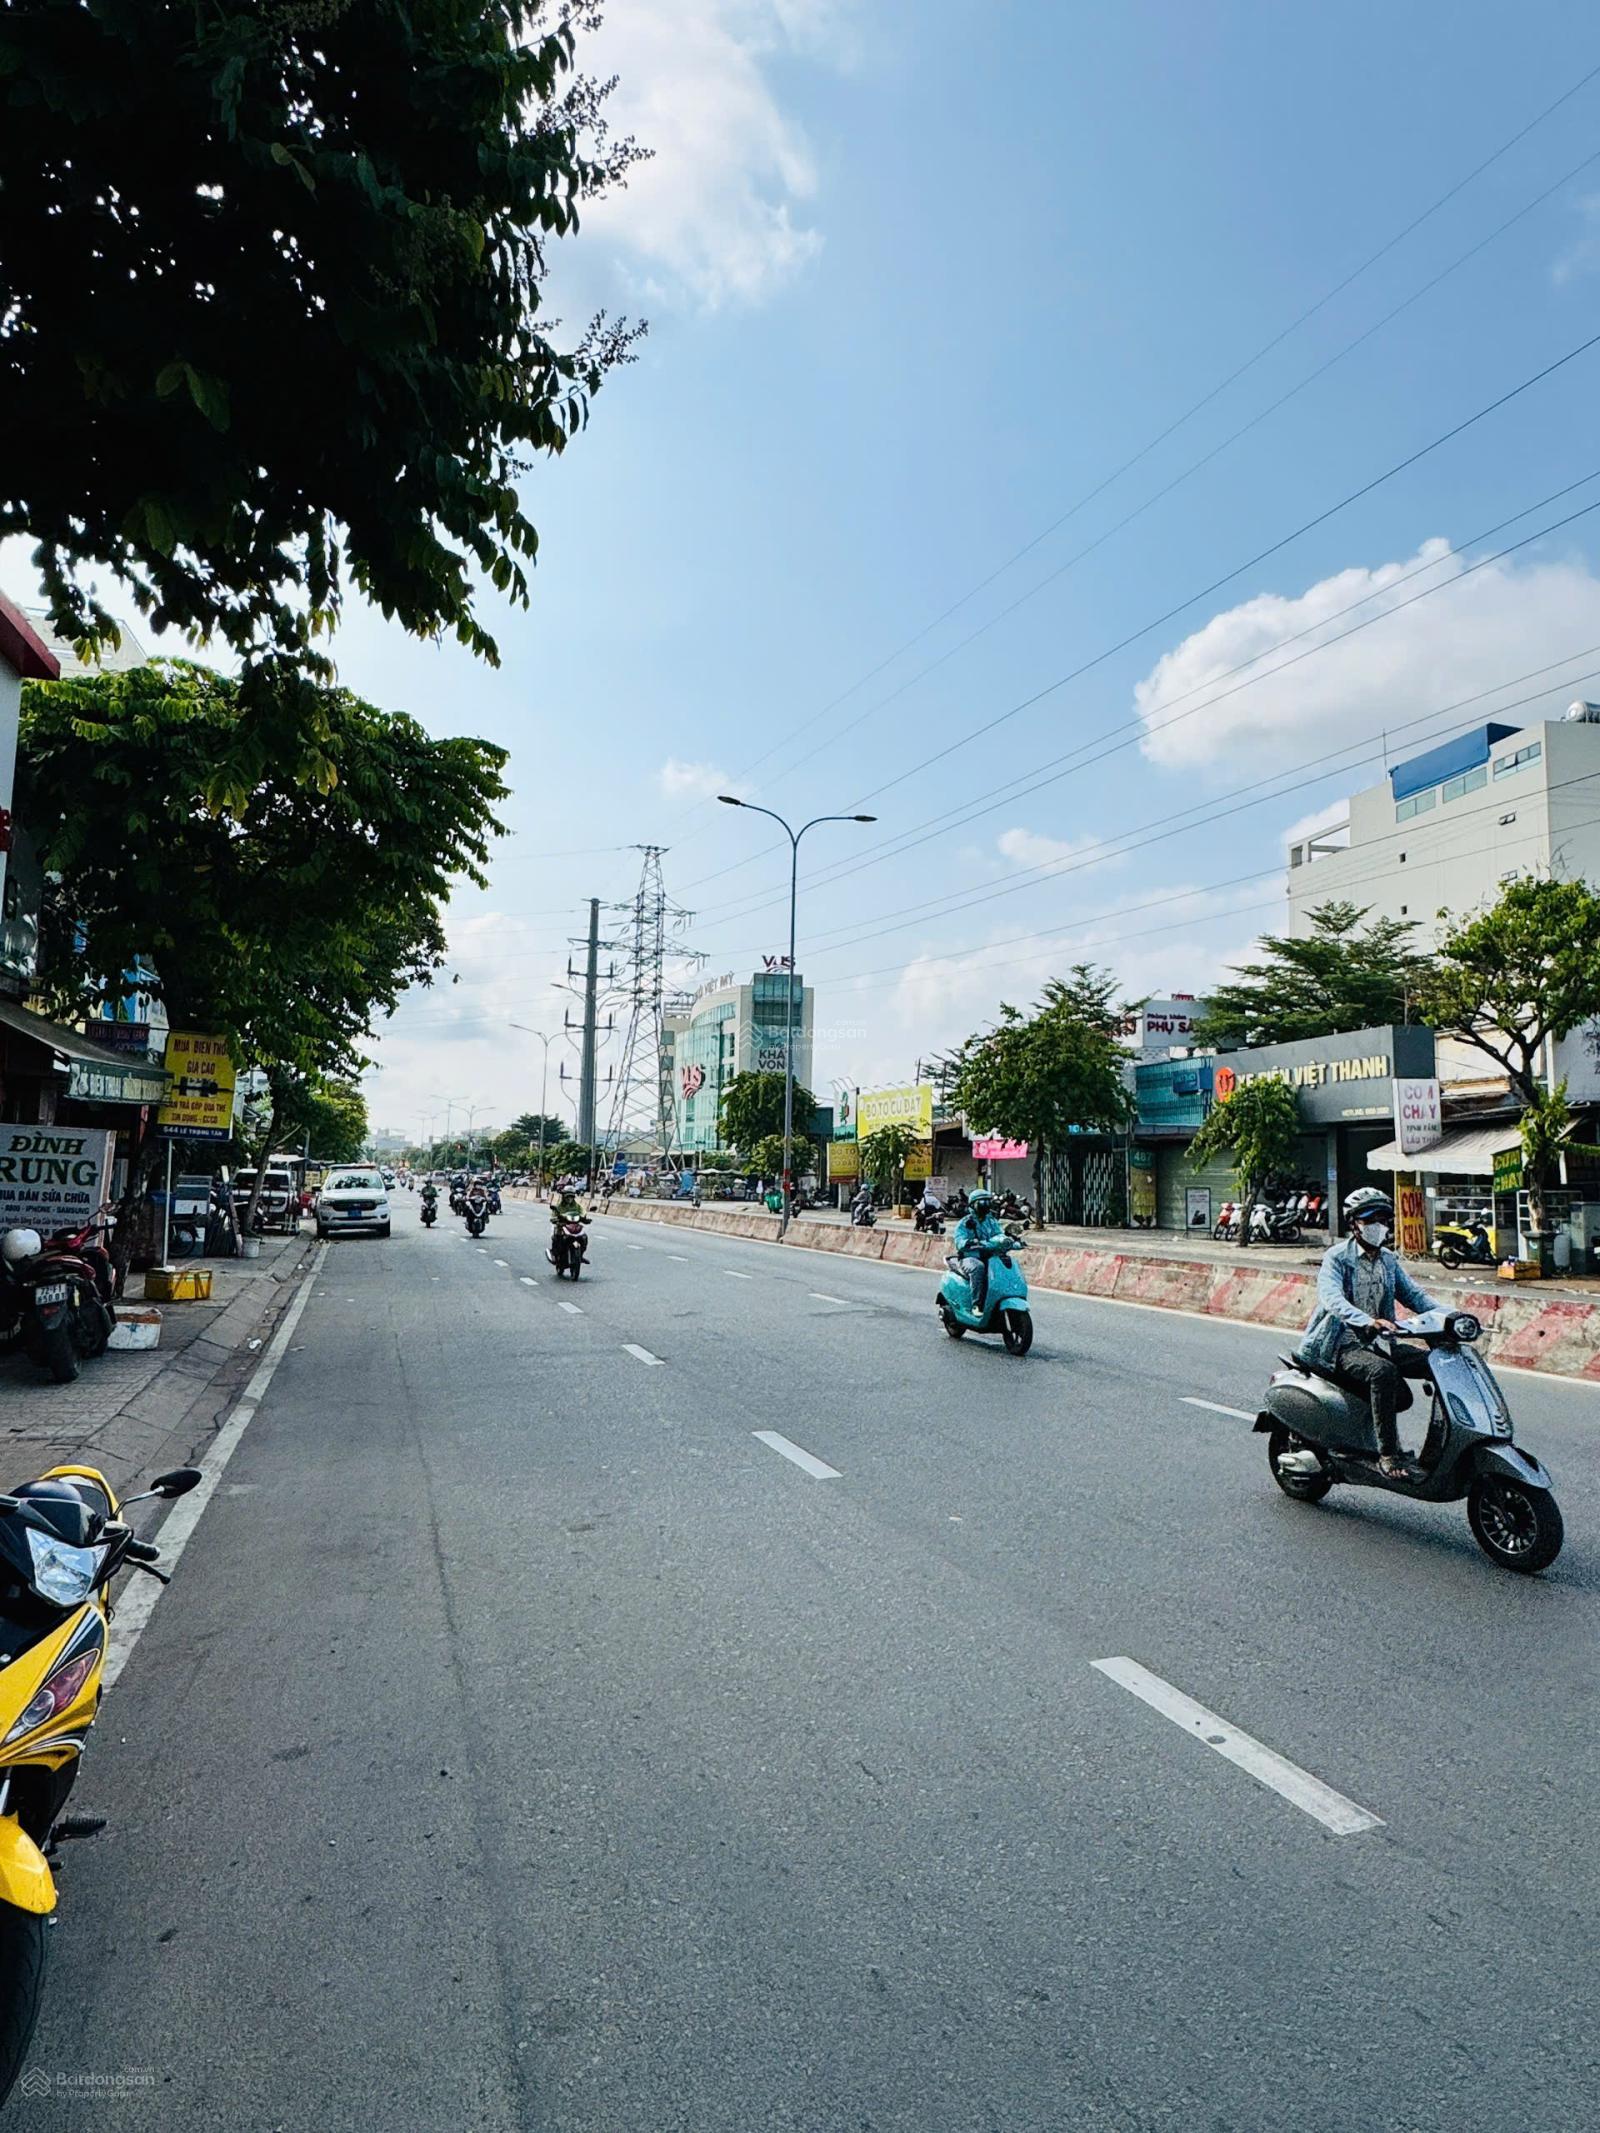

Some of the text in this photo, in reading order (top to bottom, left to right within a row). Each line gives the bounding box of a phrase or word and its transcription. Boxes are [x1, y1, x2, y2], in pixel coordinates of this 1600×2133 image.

[1147, 1021, 1174, 1035] PHỤ
[1295, 1060, 1327, 1089] VIỆT
[1330, 1055, 1390, 1082] THANH
[8, 1131, 87, 1155] ĐÌNH
